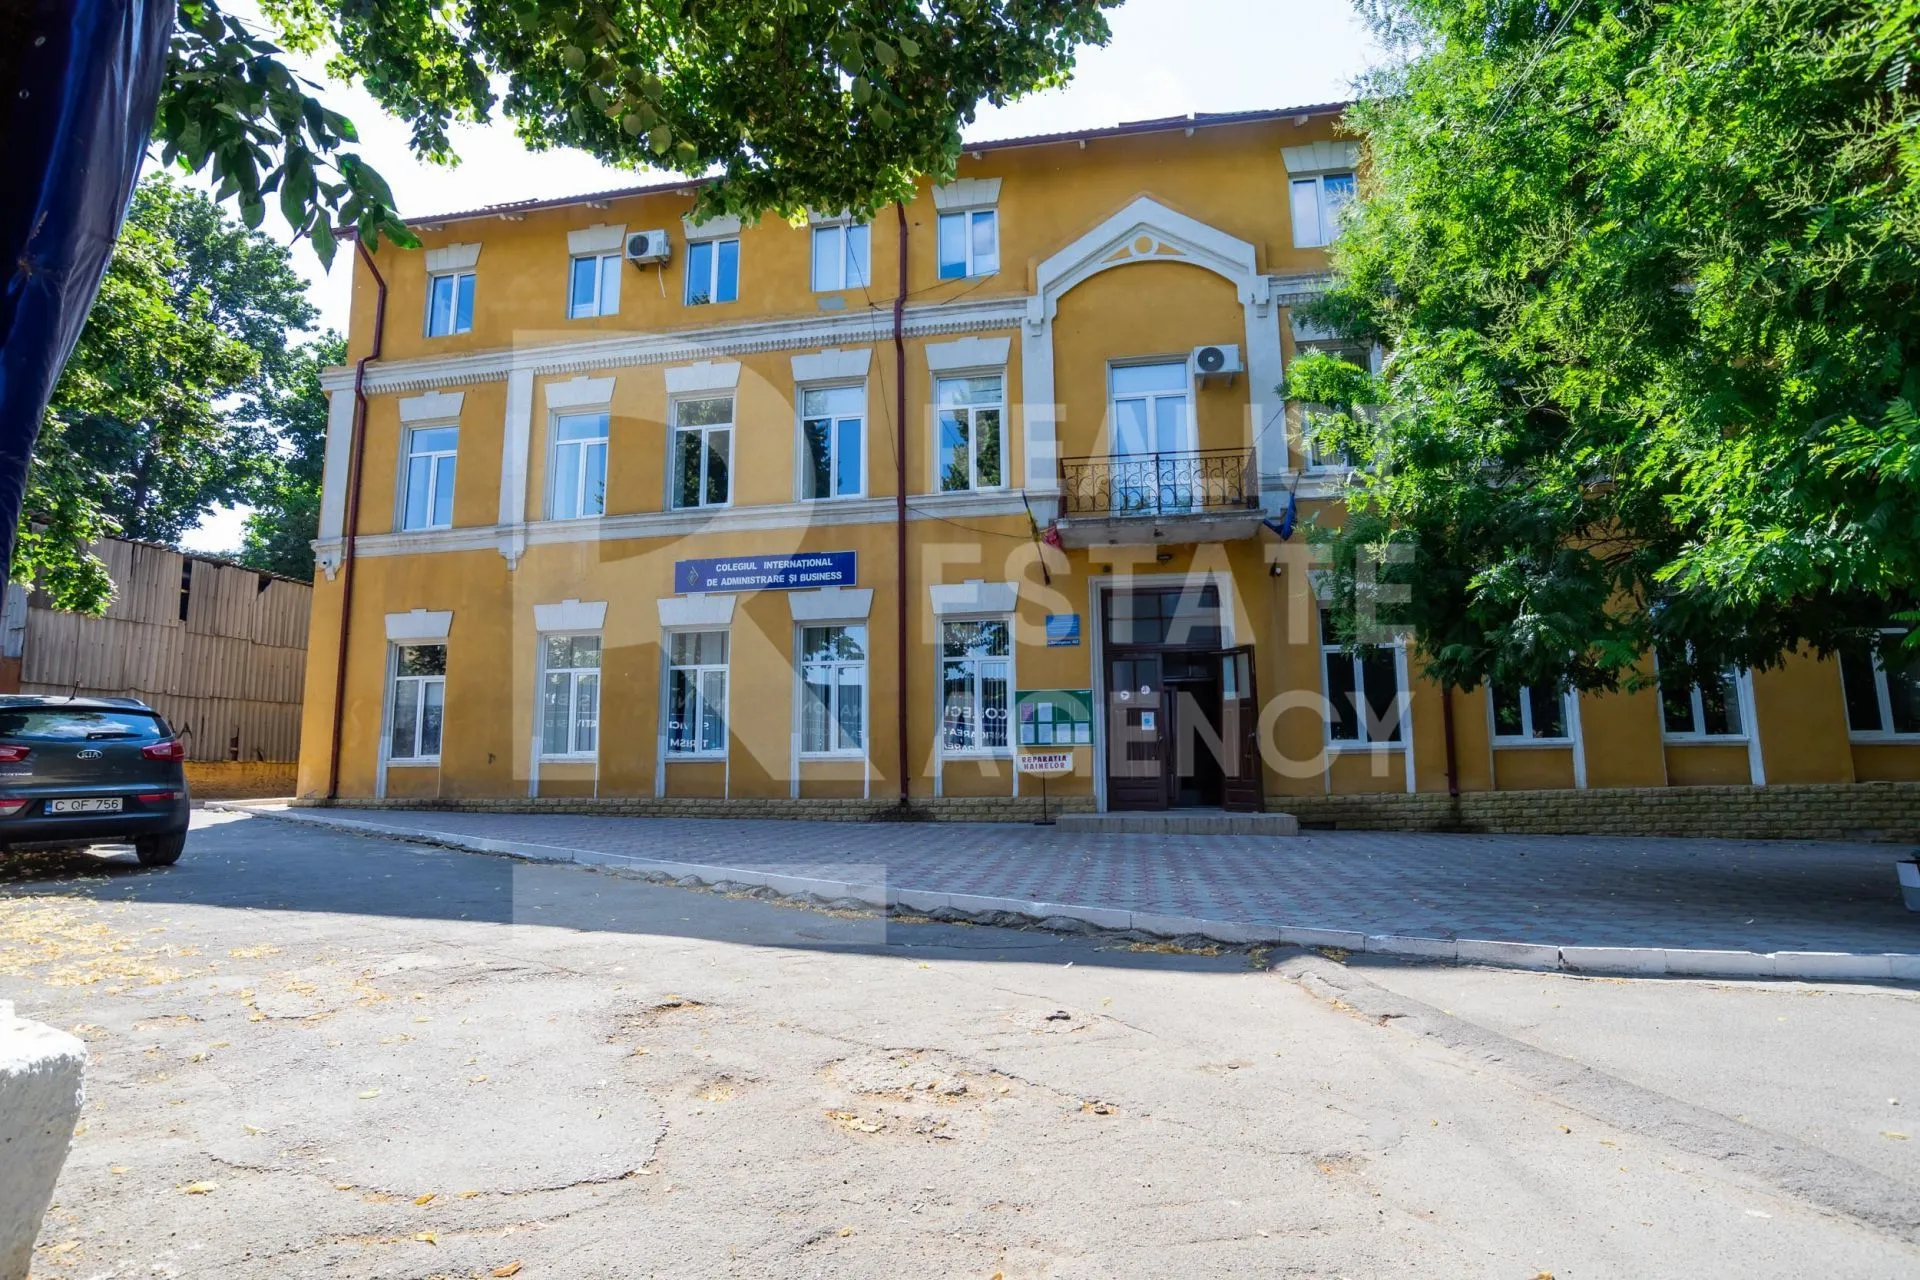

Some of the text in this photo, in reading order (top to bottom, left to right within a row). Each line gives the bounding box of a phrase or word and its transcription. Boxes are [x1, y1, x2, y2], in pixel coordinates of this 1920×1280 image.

[716, 561, 757, 572] COLEGIUL
[706, 577, 718, 587] DE
[720, 574, 785, 586] ADMINISTRARE
[800, 571, 842, 582] BUSINESS
[79, 750, 101, 760] KIA
[55, 798, 119, 811] C QF 756
